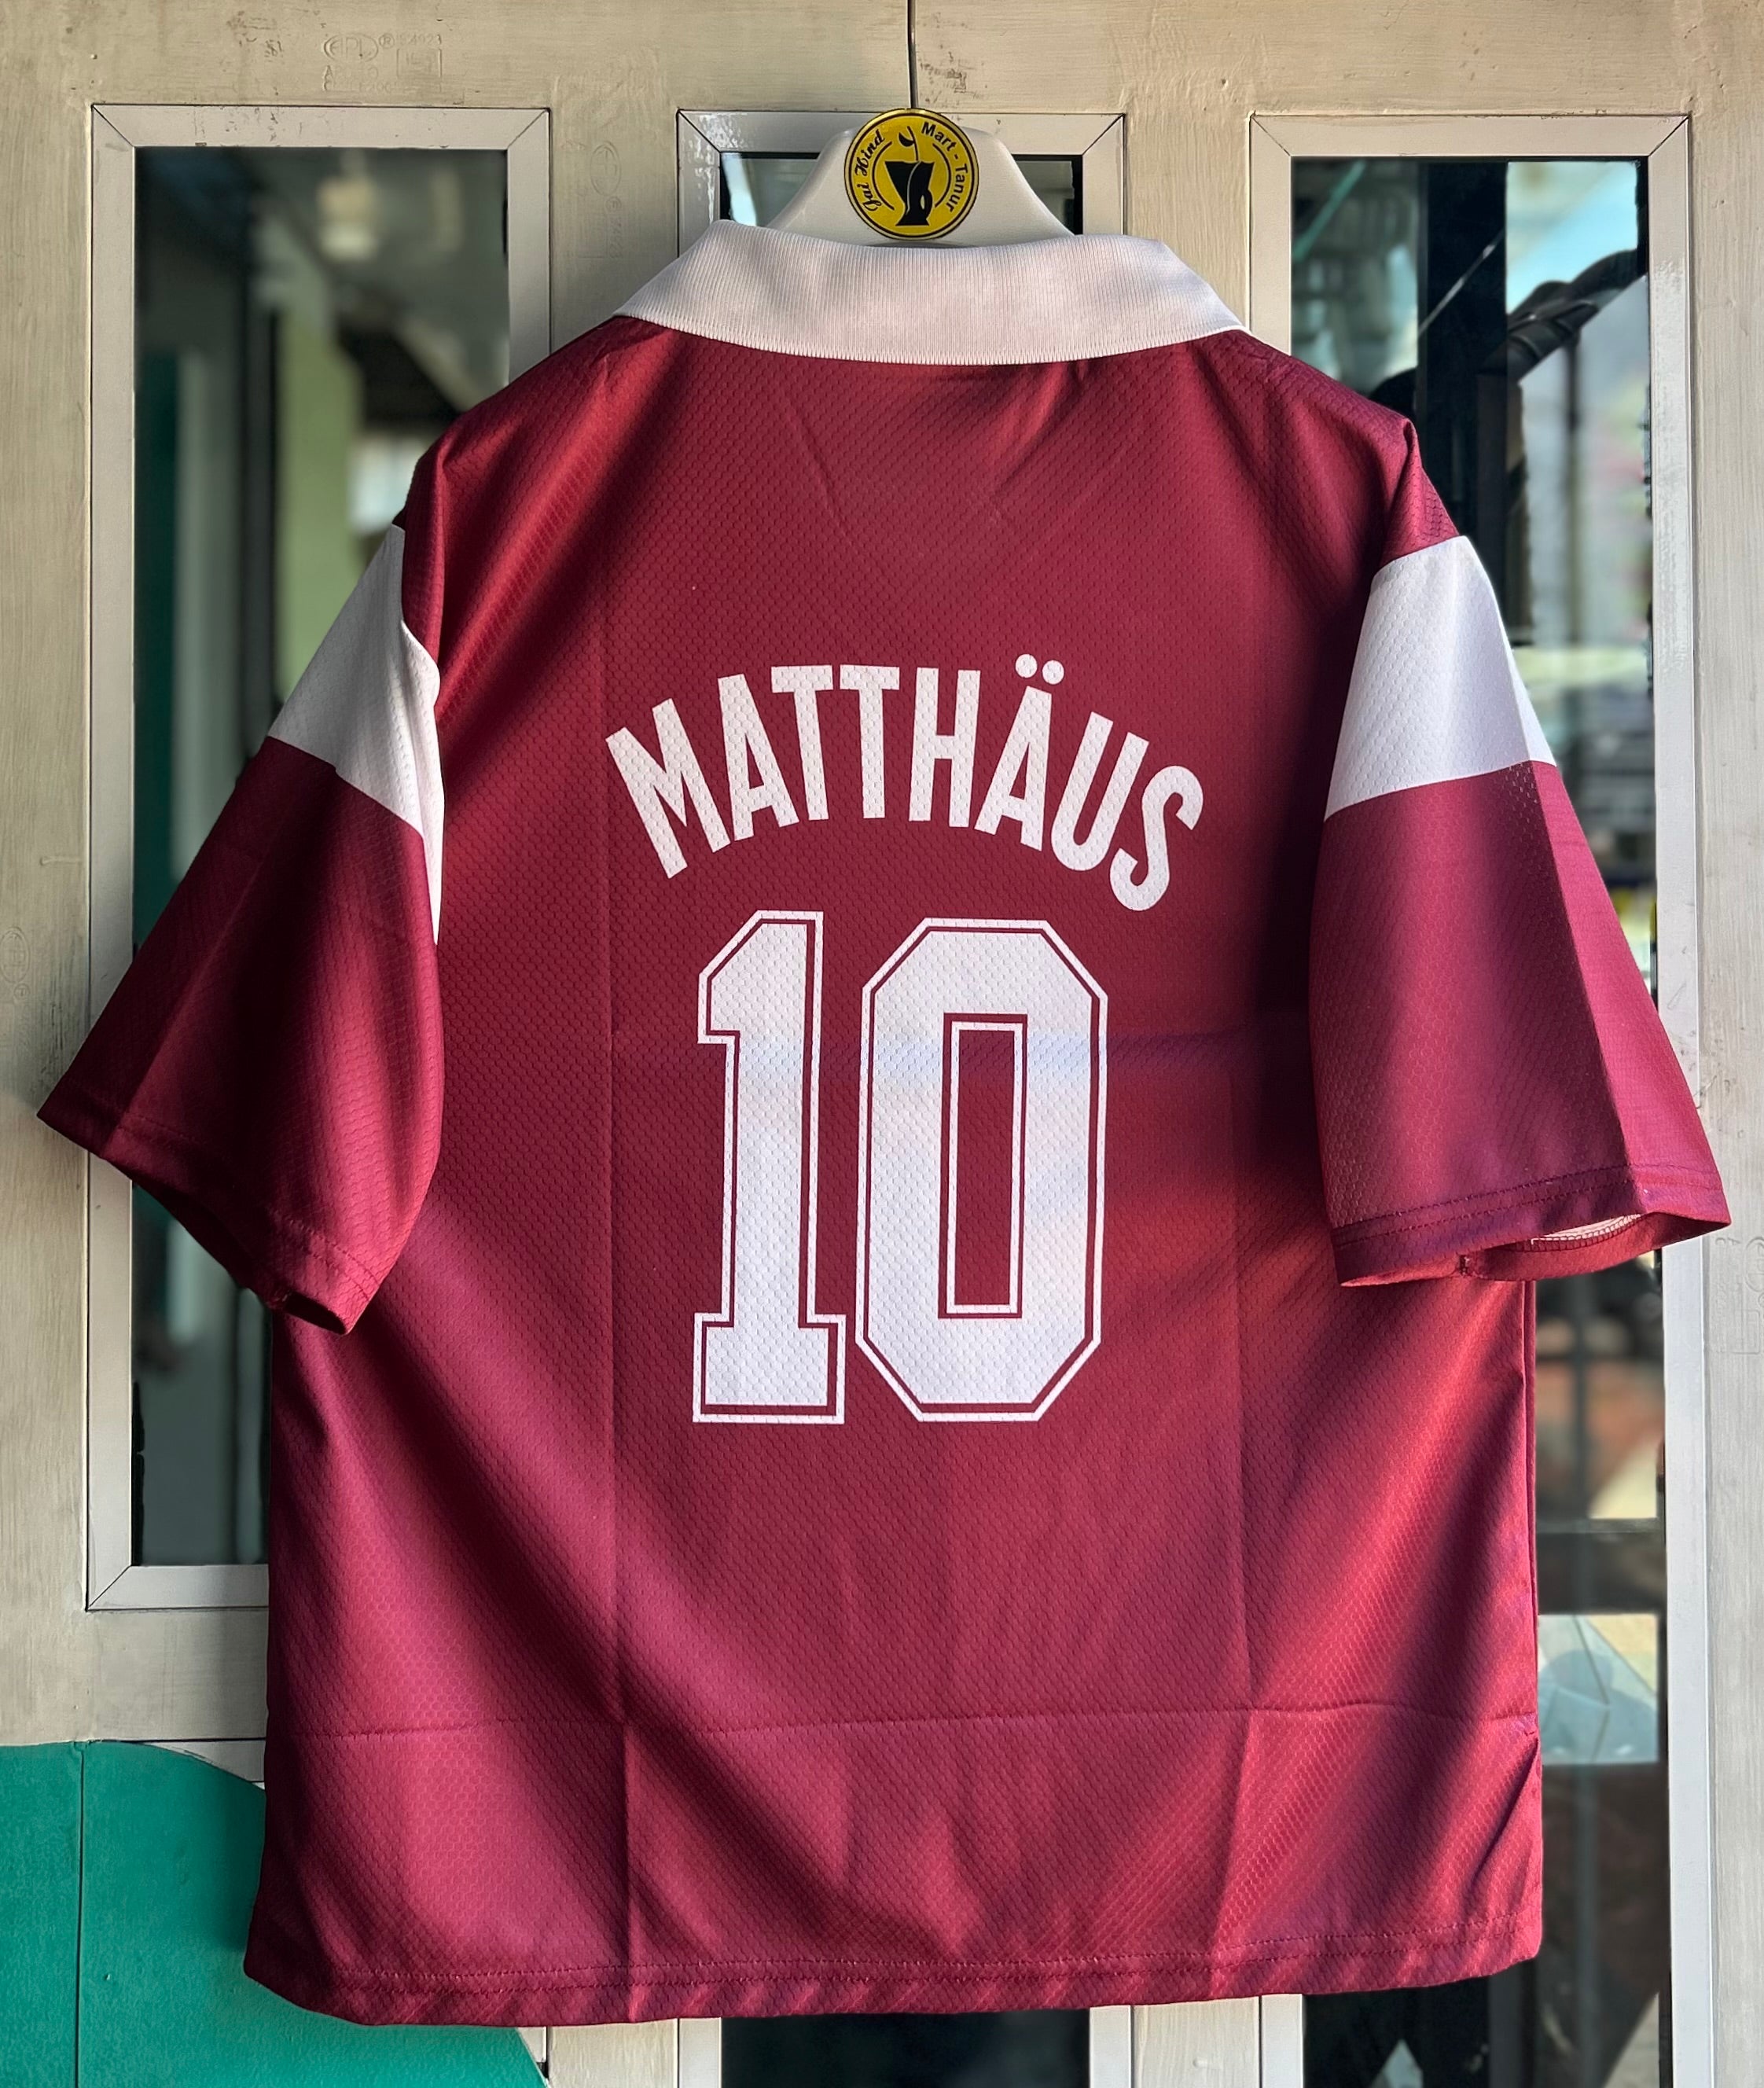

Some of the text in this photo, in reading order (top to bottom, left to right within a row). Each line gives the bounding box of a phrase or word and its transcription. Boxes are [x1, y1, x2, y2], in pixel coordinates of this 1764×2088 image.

[854, 129, 885, 176] Hind
[921, 122, 957, 152] Mart
[857, 182, 882, 211] Jai
[946, 164, 968, 212] Tanur
[606, 654, 1204, 910] MATTHÄUS
[693, 910, 1108, 1424] 10
